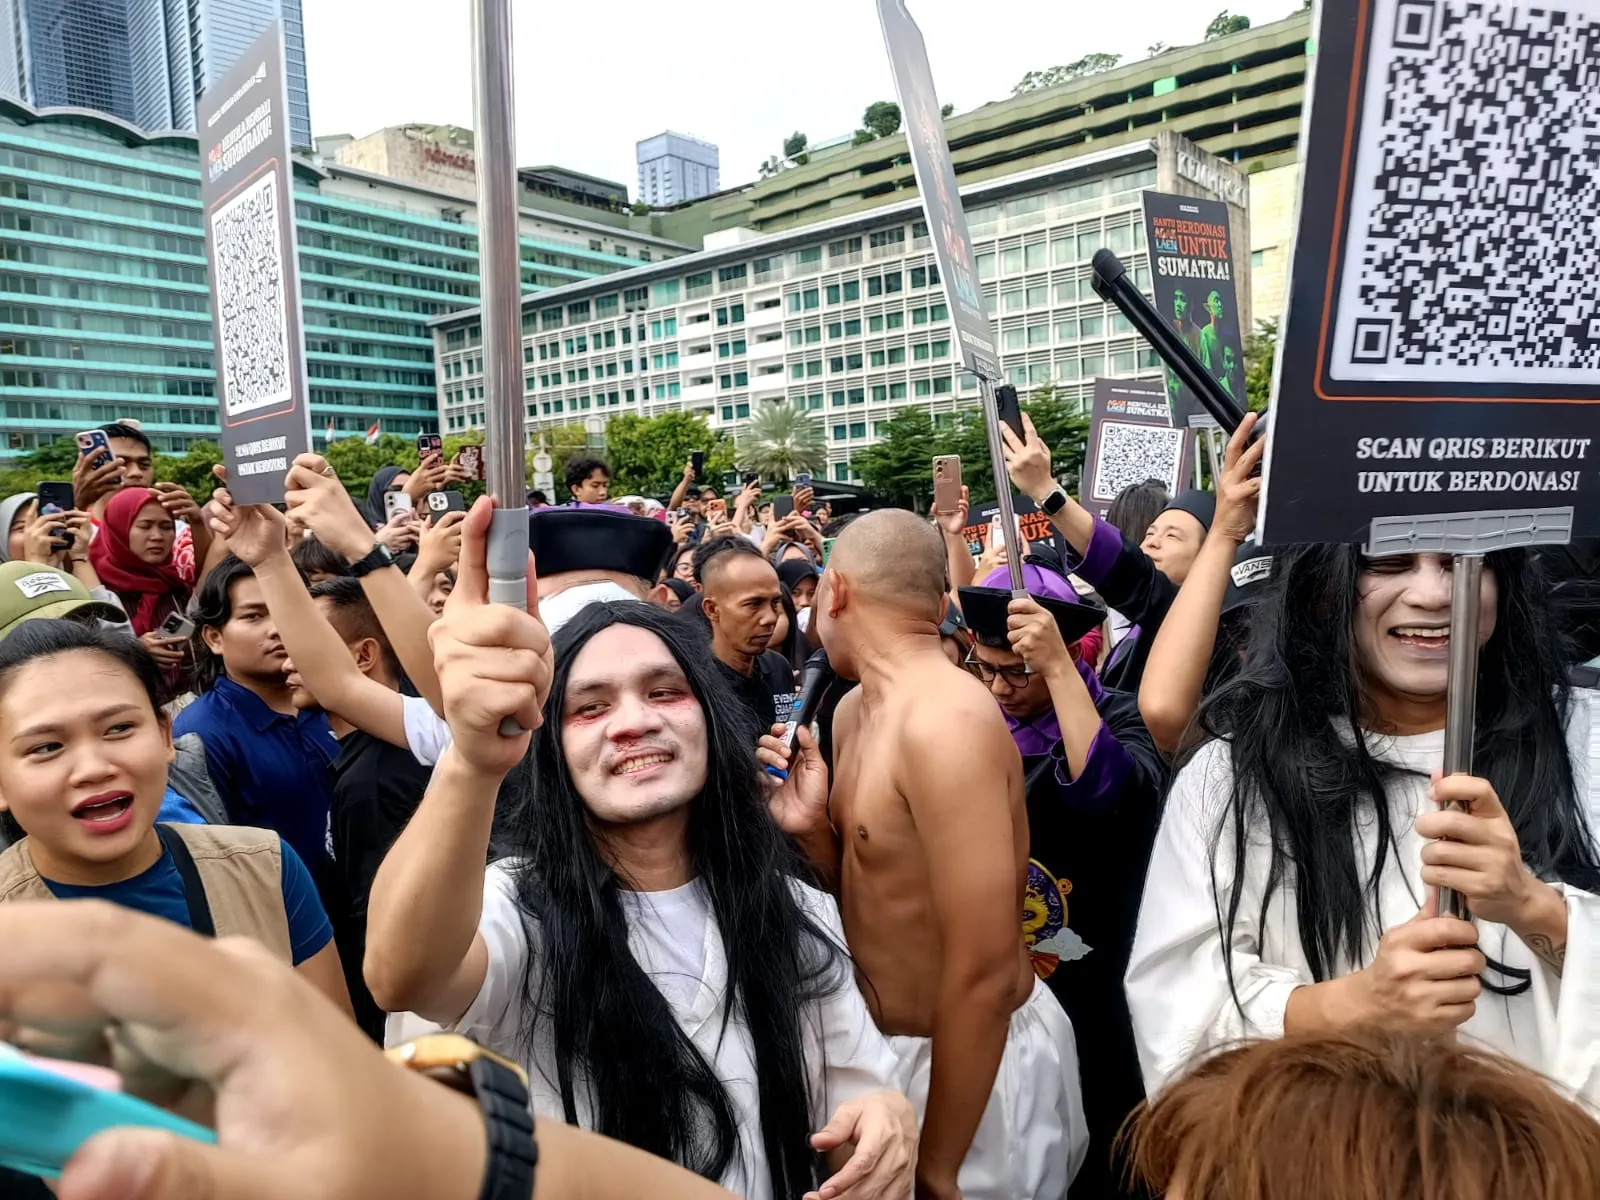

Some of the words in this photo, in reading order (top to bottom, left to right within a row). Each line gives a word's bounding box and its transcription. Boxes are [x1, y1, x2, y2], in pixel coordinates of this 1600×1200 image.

[1176, 220, 1226, 238] BERDONASI
[1178, 235, 1228, 259] UNTUK
[1158, 256, 1230, 280] SUMATRA!
[1356, 437, 1424, 459] SCAN
[1428, 437, 1485, 461] QRIS
[1489, 438, 1591, 459] BERIKUT
[1357, 471, 1444, 493] UNTUK
[1447, 471, 1580, 492] BERDONASI
[1238, 560, 1271, 574] VANS
